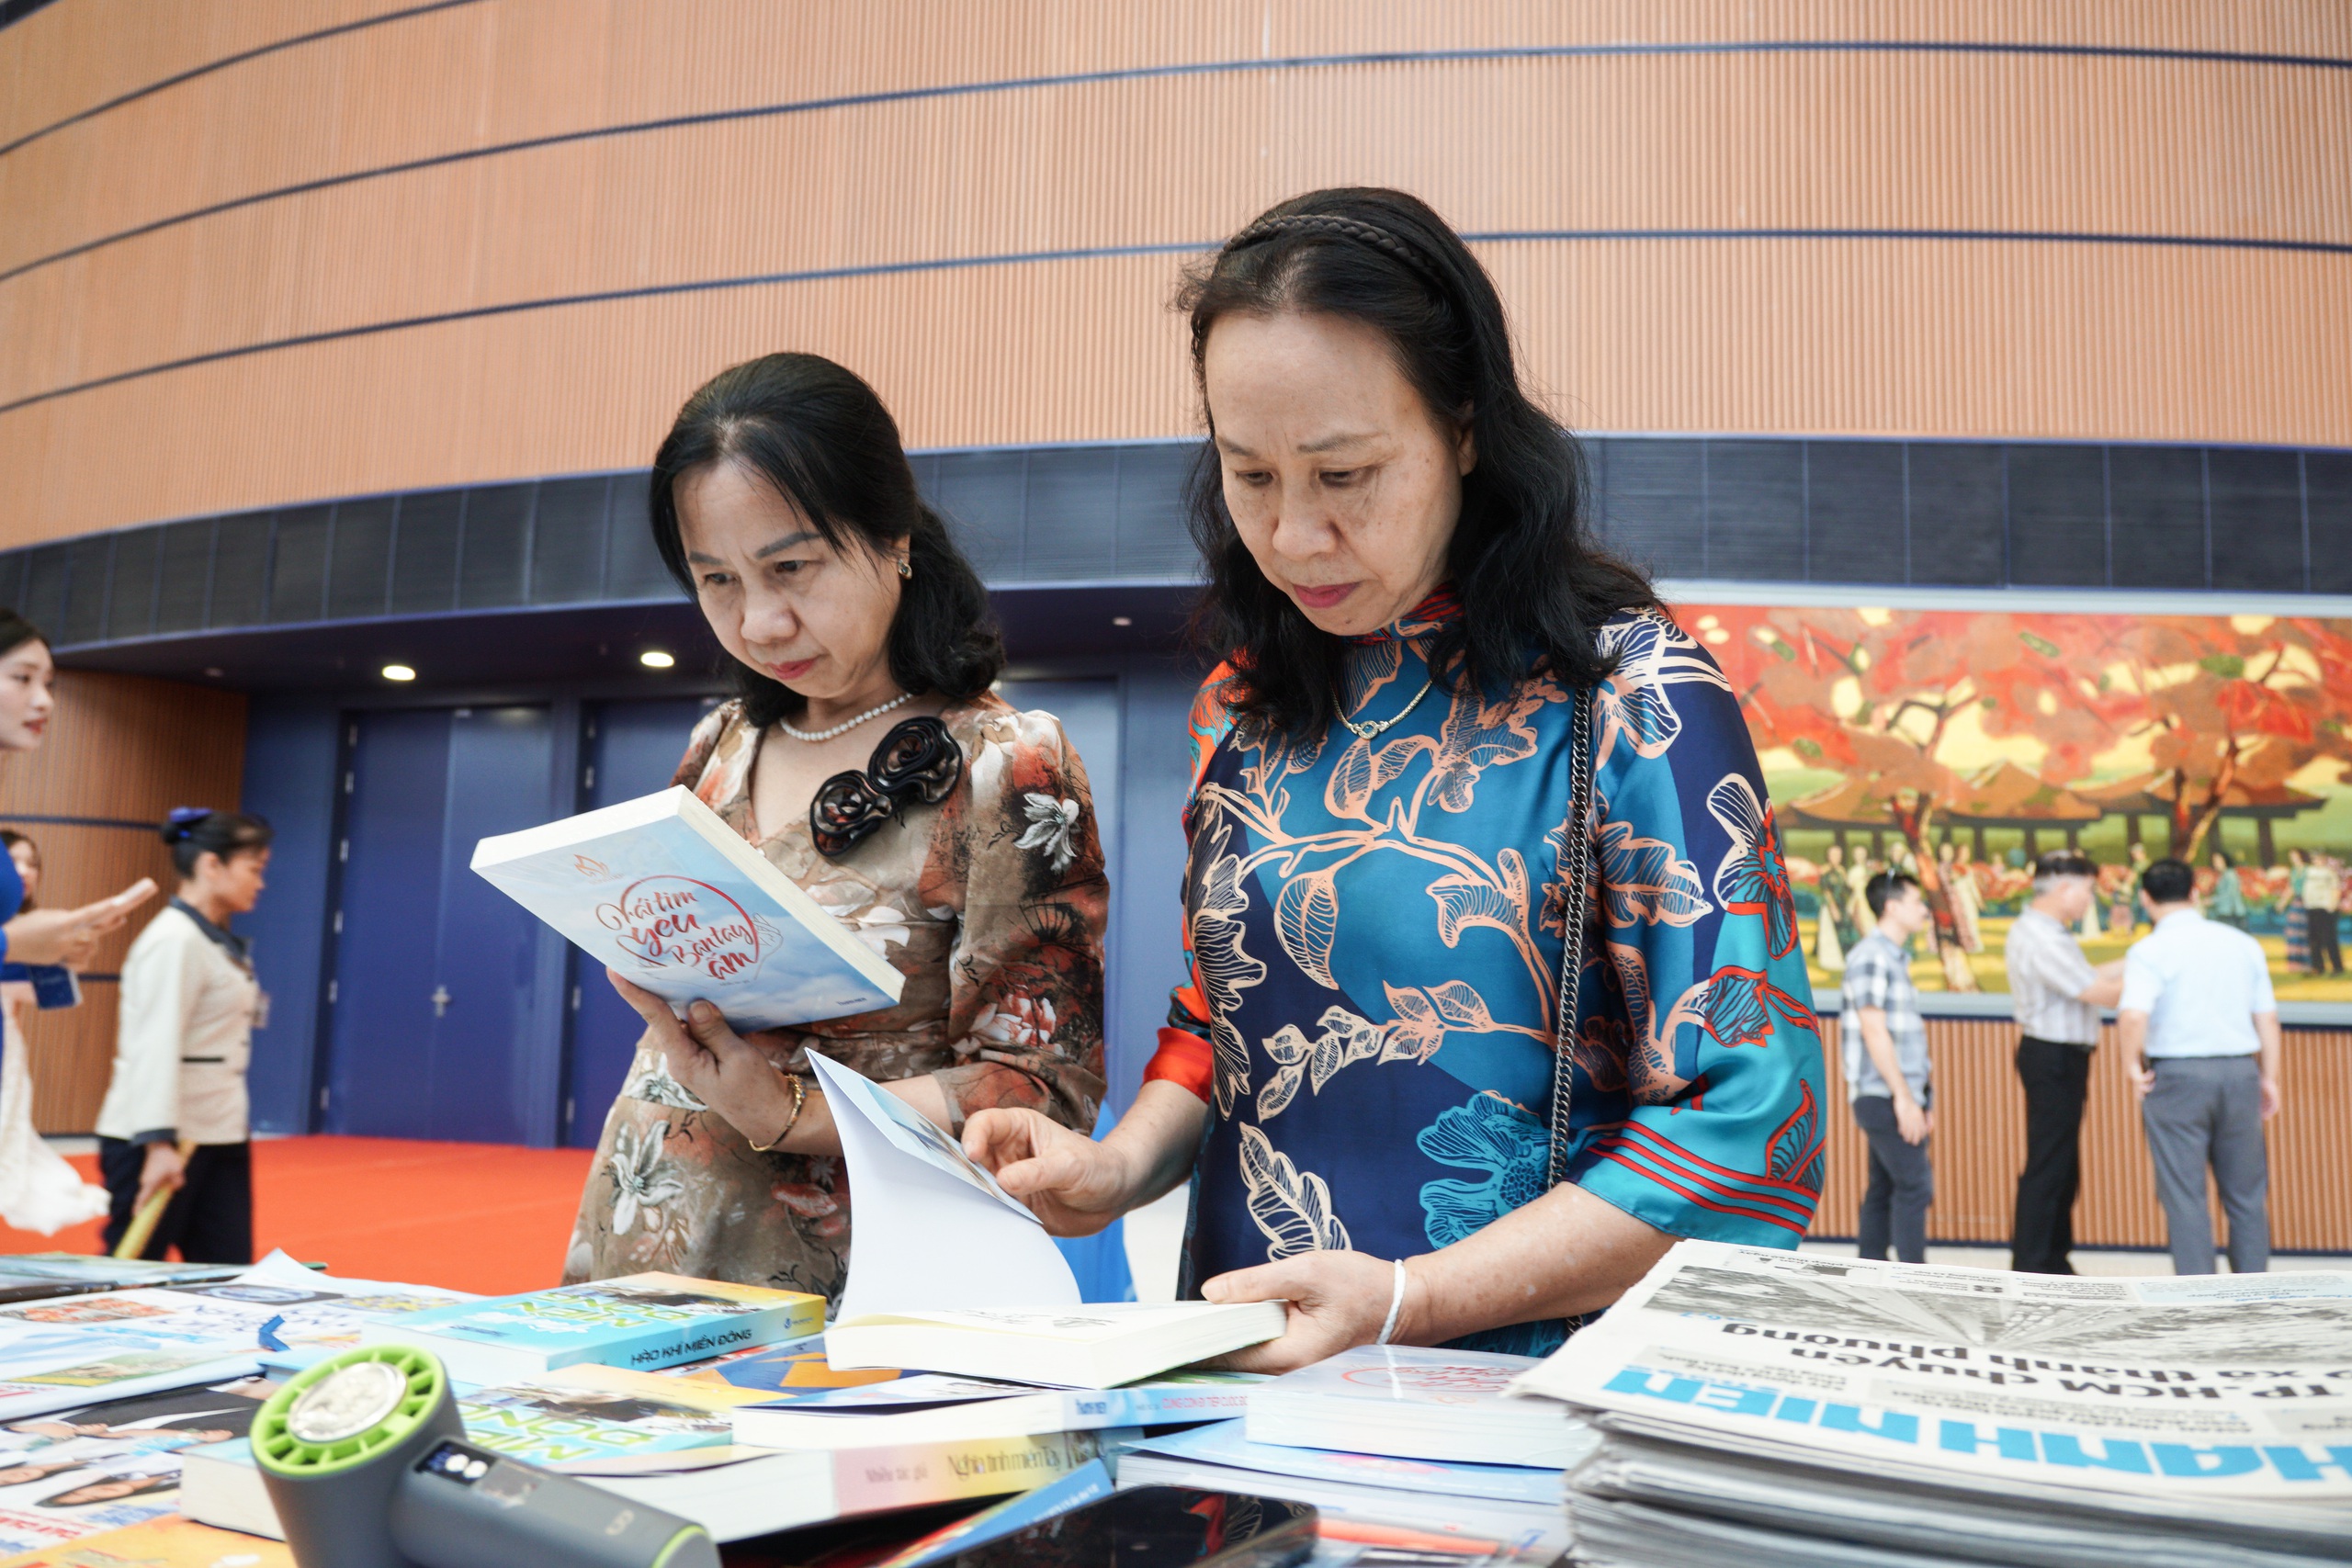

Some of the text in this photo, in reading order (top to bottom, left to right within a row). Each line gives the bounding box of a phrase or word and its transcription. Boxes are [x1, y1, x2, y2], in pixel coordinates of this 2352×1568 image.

[653, 891, 698, 912] tim
[630, 1328, 752, 1366] HÀO KHÍ MIỀN ĐÔNG
[1722, 1324, 1968, 1359] phường
